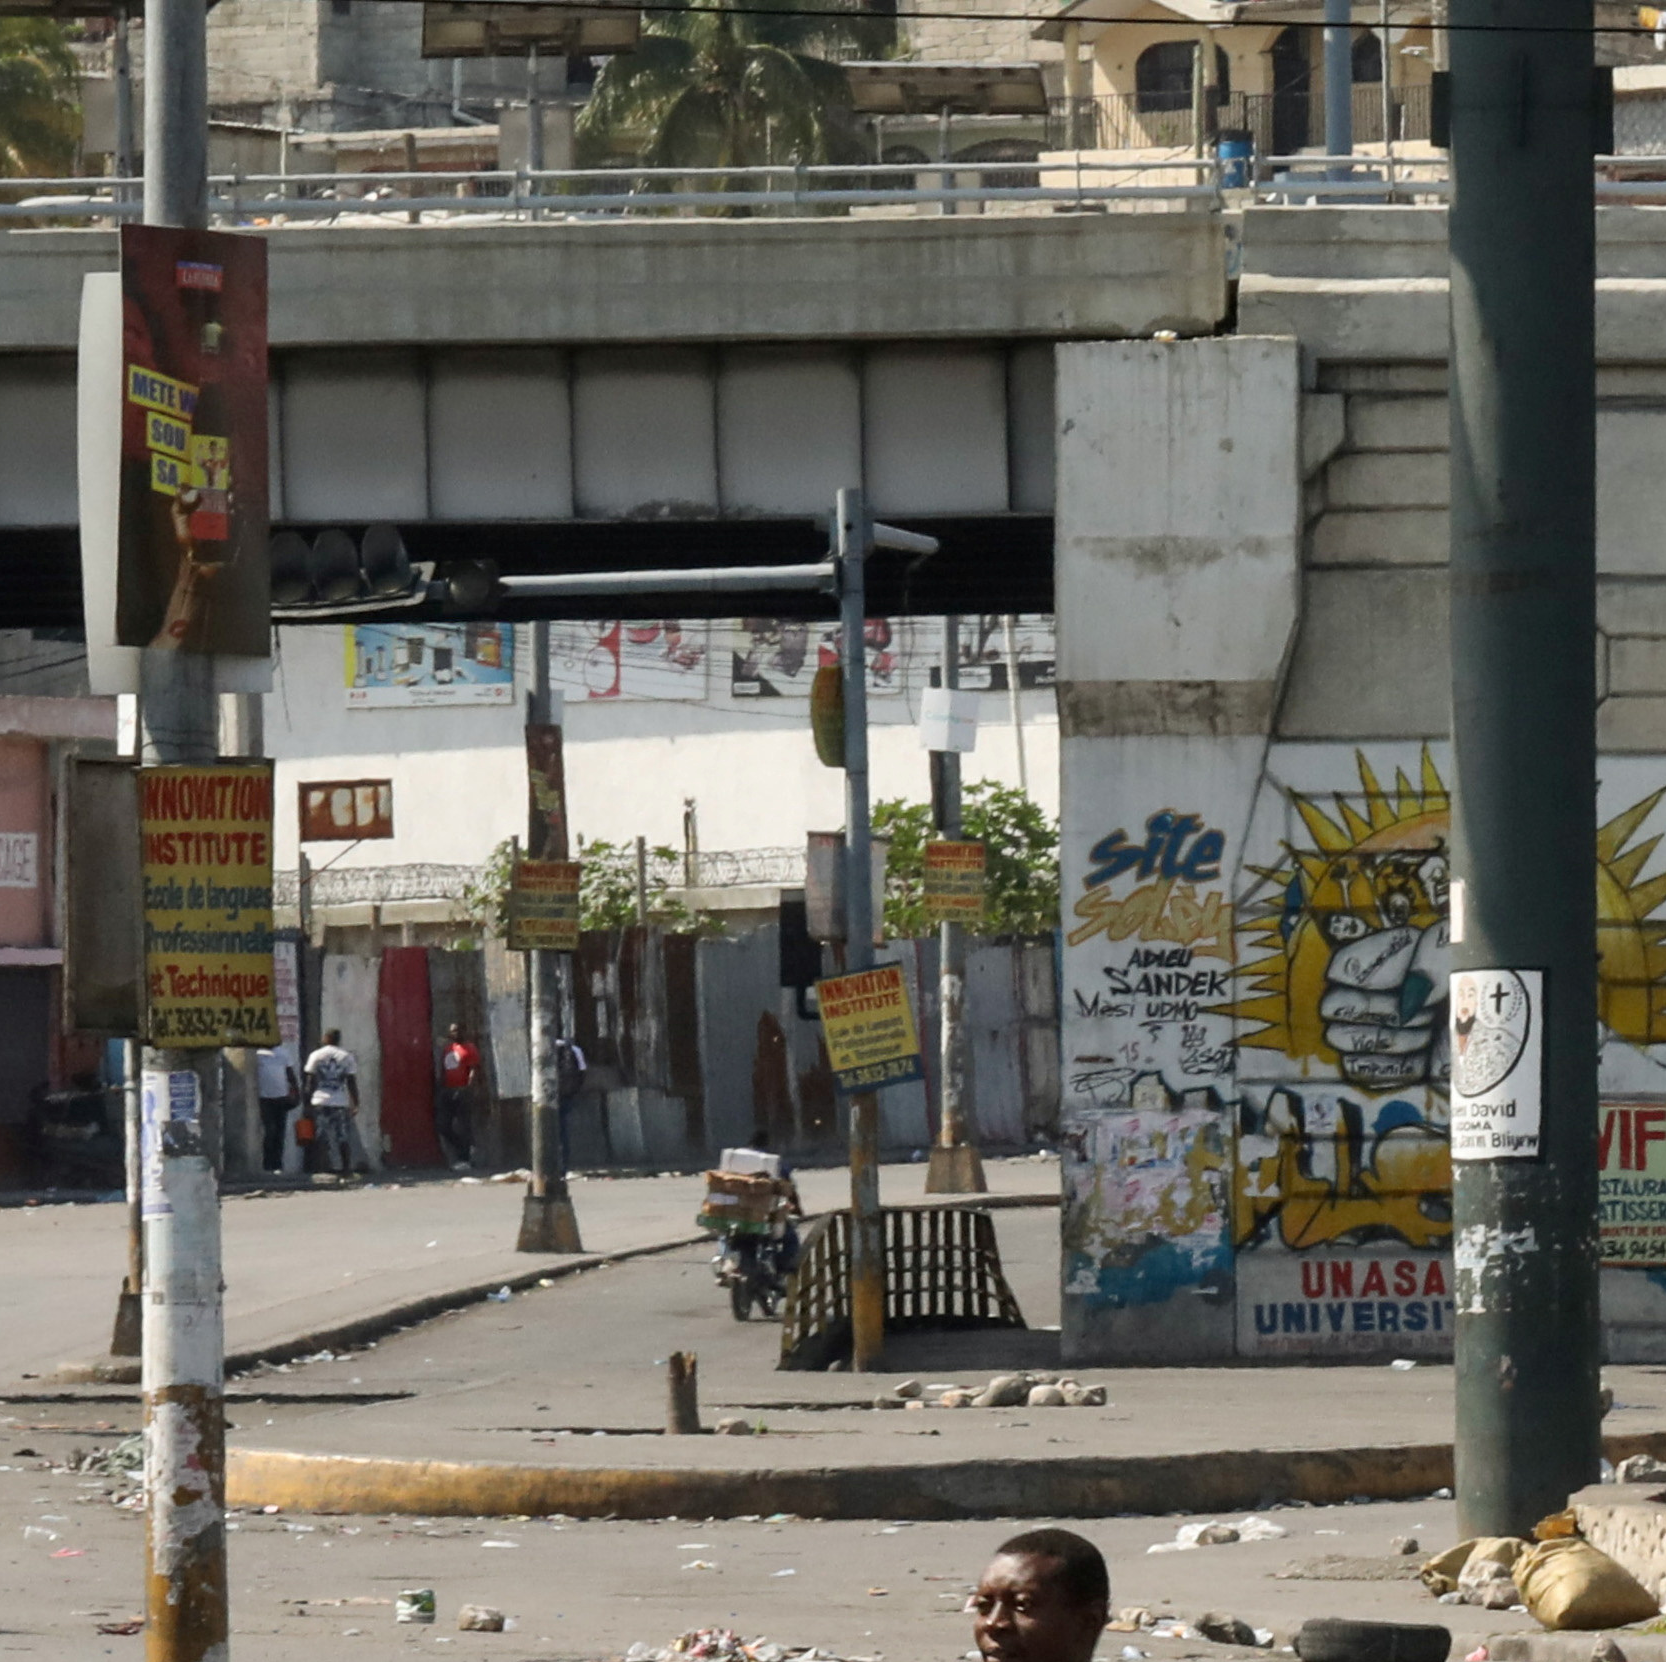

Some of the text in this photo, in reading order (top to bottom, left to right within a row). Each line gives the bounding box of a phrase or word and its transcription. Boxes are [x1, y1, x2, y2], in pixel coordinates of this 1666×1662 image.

[133, 371, 176, 408] METE
[151, 417, 187, 451] SOU
[141, 775, 271, 821] INNOVATION
[144, 831, 267, 867] INSTITUTE
[165, 963, 269, 1004] Technique
[818, 968, 902, 1002] INNOVATION
[1103, 966, 1231, 997] SANDEK
[823, 991, 902, 1020] INSTITUTE
[1471, 1099, 1516, 1118] David
